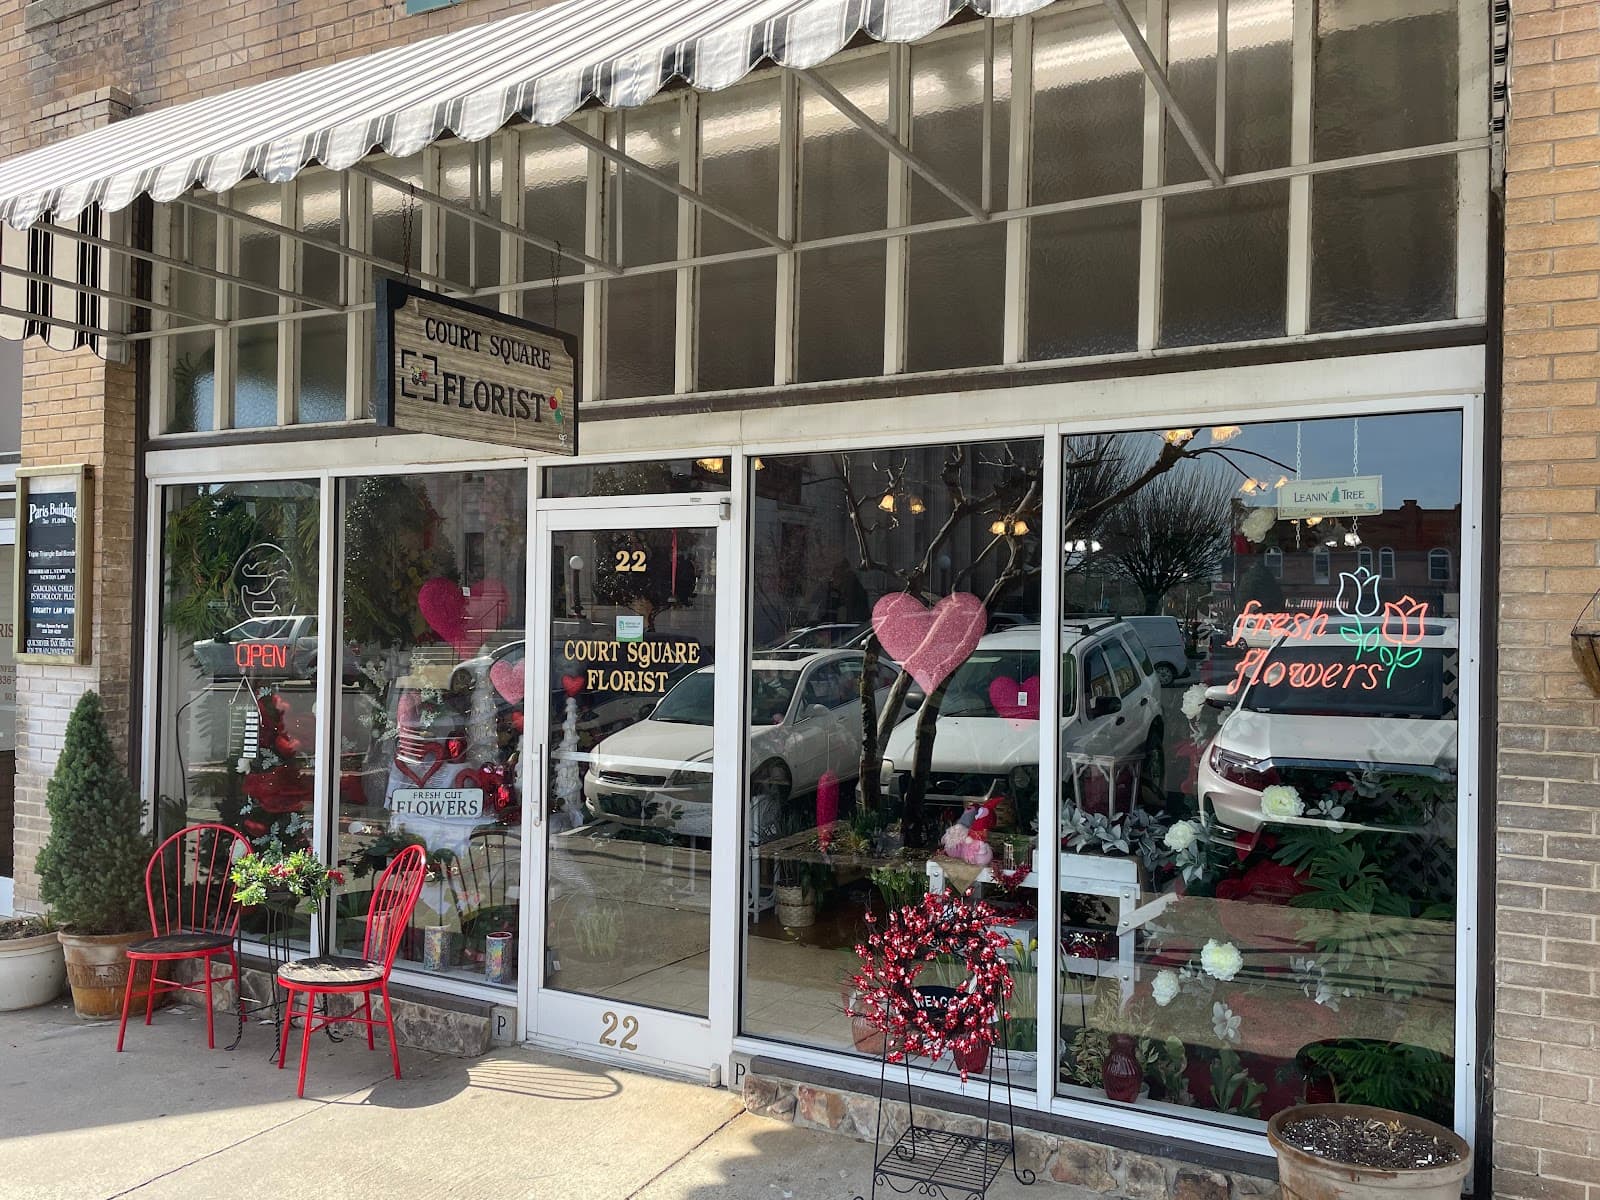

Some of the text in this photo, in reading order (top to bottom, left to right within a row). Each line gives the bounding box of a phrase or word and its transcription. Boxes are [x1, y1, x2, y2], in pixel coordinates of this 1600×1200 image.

[425, 317, 551, 371] COURT SQUARE
[442, 371, 546, 423] FLORIST
[1341, 489, 1365, 500] TREE
[28, 502, 77, 524] Paris Building
[615, 550, 647, 572] 22
[1226, 600, 1329, 647] fresh
[236, 644, 287, 669] OPEN
[564, 640, 700, 668] COURT SQUARE
[586, 669, 669, 693] FLORIST
[1227, 648, 1384, 695] flowers
[444, 791, 463, 799] CUT
[397, 800, 478, 816] FLOWERS
[912, 994, 975, 1014] WELCO
[497, 1015, 506, 1036] P
[599, 1011, 639, 1051] 22
[735, 1062, 746, 1085] P
